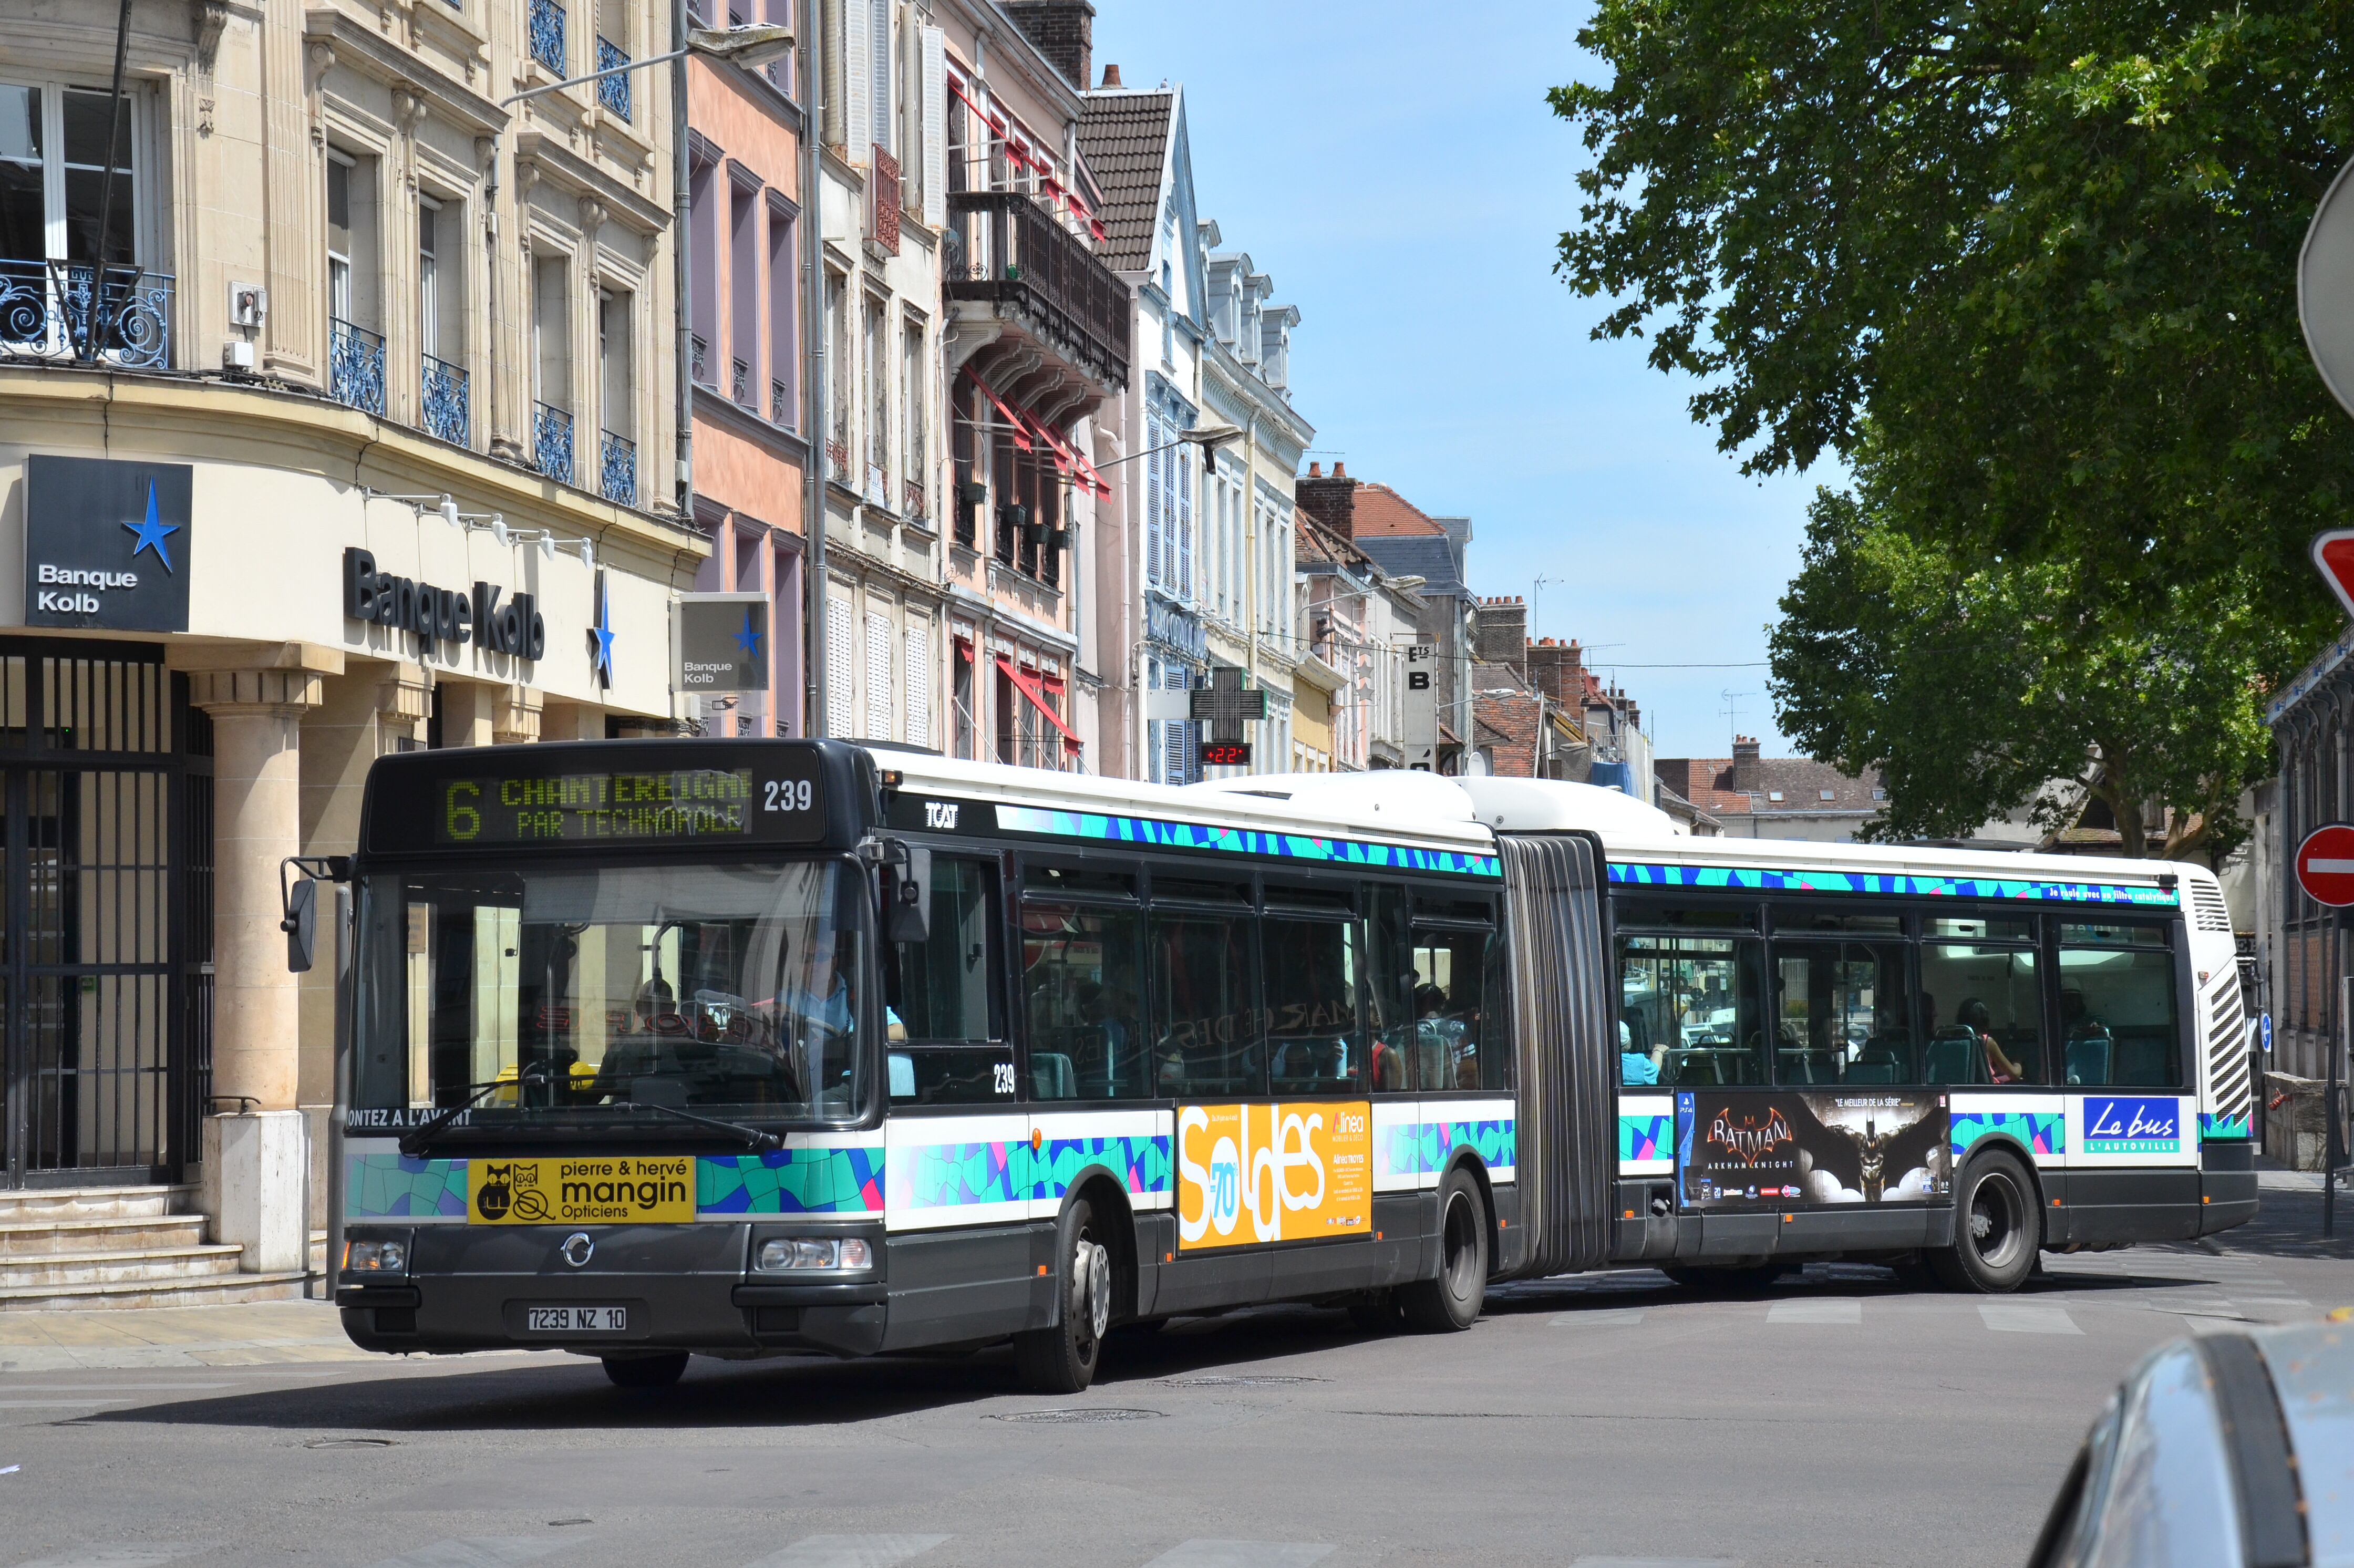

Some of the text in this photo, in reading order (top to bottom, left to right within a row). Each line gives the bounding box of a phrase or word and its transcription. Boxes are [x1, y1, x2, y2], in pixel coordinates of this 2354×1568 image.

[38, 564, 138, 591] Banque
[38, 591, 100, 613] Kolb
[345, 547, 545, 661] Banque Kolb
[684, 662, 732, 673] Banque
[684, 673, 714, 683] Kolb
[500, 771, 752, 806] CHANTEREIGNE
[763, 780, 812, 812] 239
[446, 781, 480, 840] 6
[517, 804, 742, 838] PAR TECHNOPOLE
[2050, 887, 2058, 896] Je
[2060, 888, 2080, 897] roule
[2113, 890, 2132, 900] filtre
[2134, 892, 2175, 903] catalytique
[994, 1064, 1015, 1093] 239
[1844, 1098, 1867, 1107] MEILLEUR
[1869, 1098, 1876, 1107] DE
[1877, 1098, 1884, 1107] LA
[347, 1109, 388, 1126] ONTEZ
[392, 1110, 403, 1126] A
[1333, 1111, 1364, 1133] Alinéa
[2090, 1101, 2174, 1138] Le bus
[1714, 1119, 1787, 1161] BATMAN
[2090, 1142, 2174, 1150] L'AUTOVILLE
[561, 1159, 687, 1179] pierre & hervé
[1348, 1154, 1364, 1163] TROYES
[1754, 1160, 1794, 1169] KNIGHT
[1179, 1103, 1325, 1242] Soldes
[561, 1176, 686, 1210] mangin
[1715, 1188, 1721, 1196] 20
[561, 1205, 628, 1220] Opticiens
[530, 1309, 624, 1328] 7239 NZ 10
